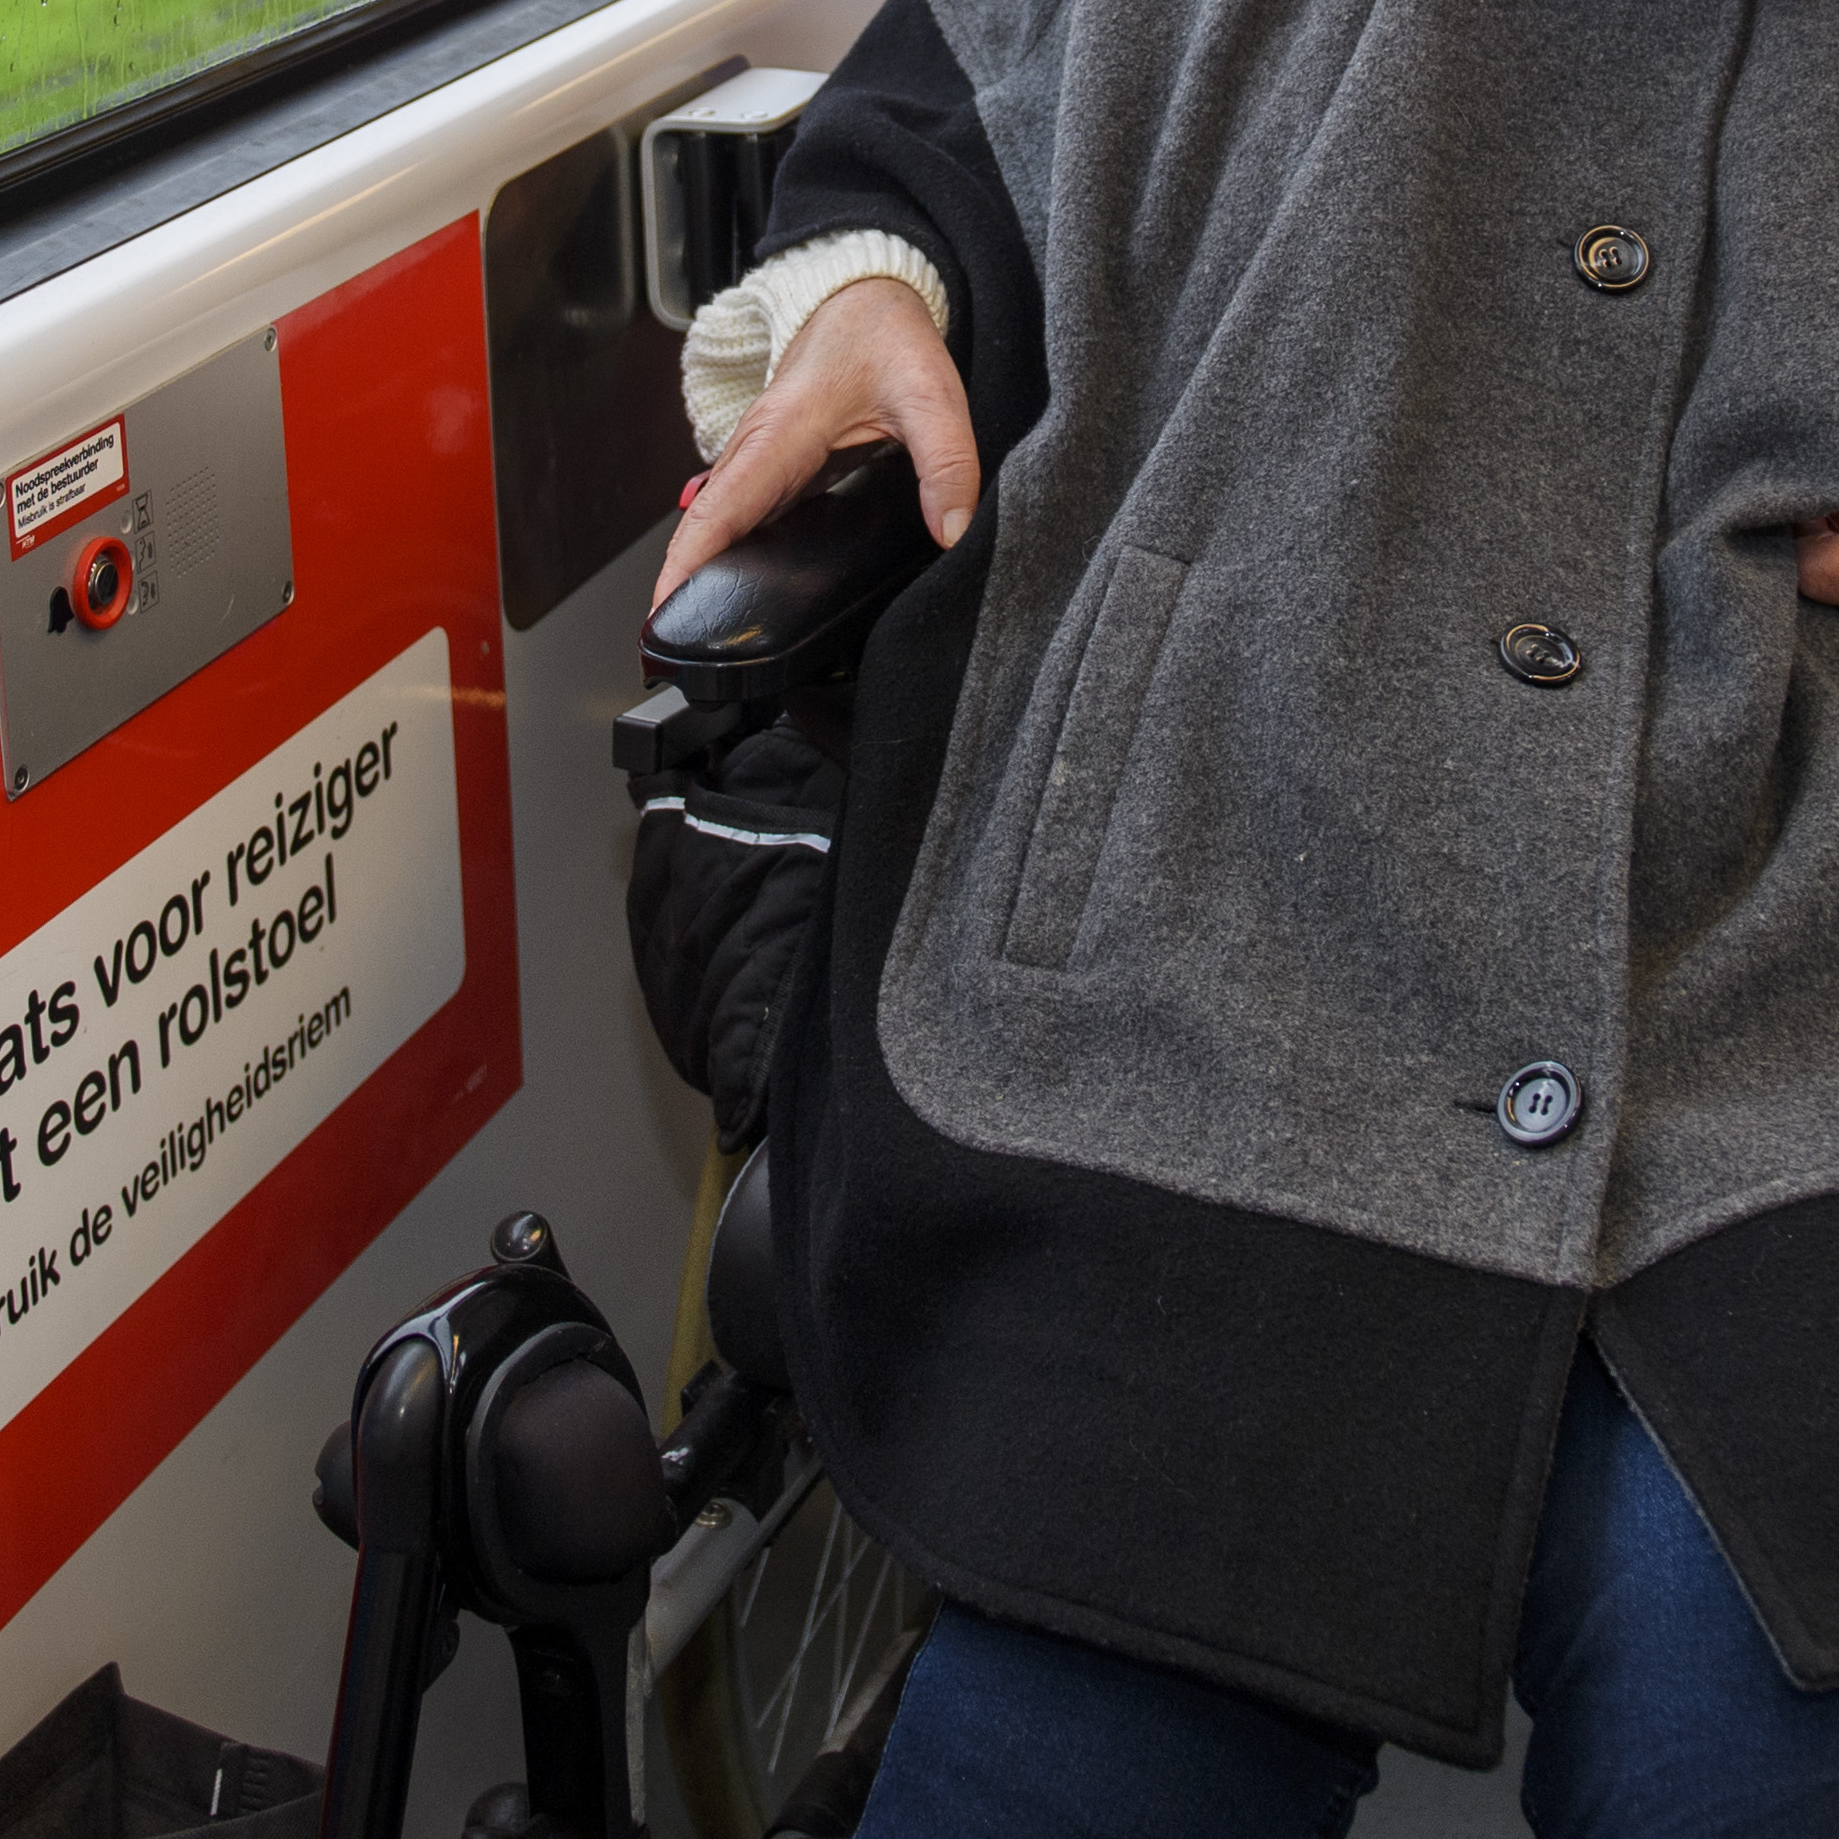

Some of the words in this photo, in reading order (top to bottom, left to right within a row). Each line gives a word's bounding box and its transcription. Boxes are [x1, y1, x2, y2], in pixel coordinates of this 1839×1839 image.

[15, 434, 114, 498] Noodspreekverbinding
[17, 494, 35, 514] met
[37, 488, 49, 501] de
[51, 459, 99, 495] bestuurder
[18, 504, 48, 528] Misbruik
[49, 501, 55, 511] is
[56, 484, 86, 507] strafbaar
[93, 870, 211, 1008] voor
[226, 721, 398, 907] reiziger
[37, 1040, 141, 1167] een
[159, 852, 337, 1070] rolstoel
[69, 1208, 113, 1267] de
[121, 986, 352, 1218] veiligheidsriem
